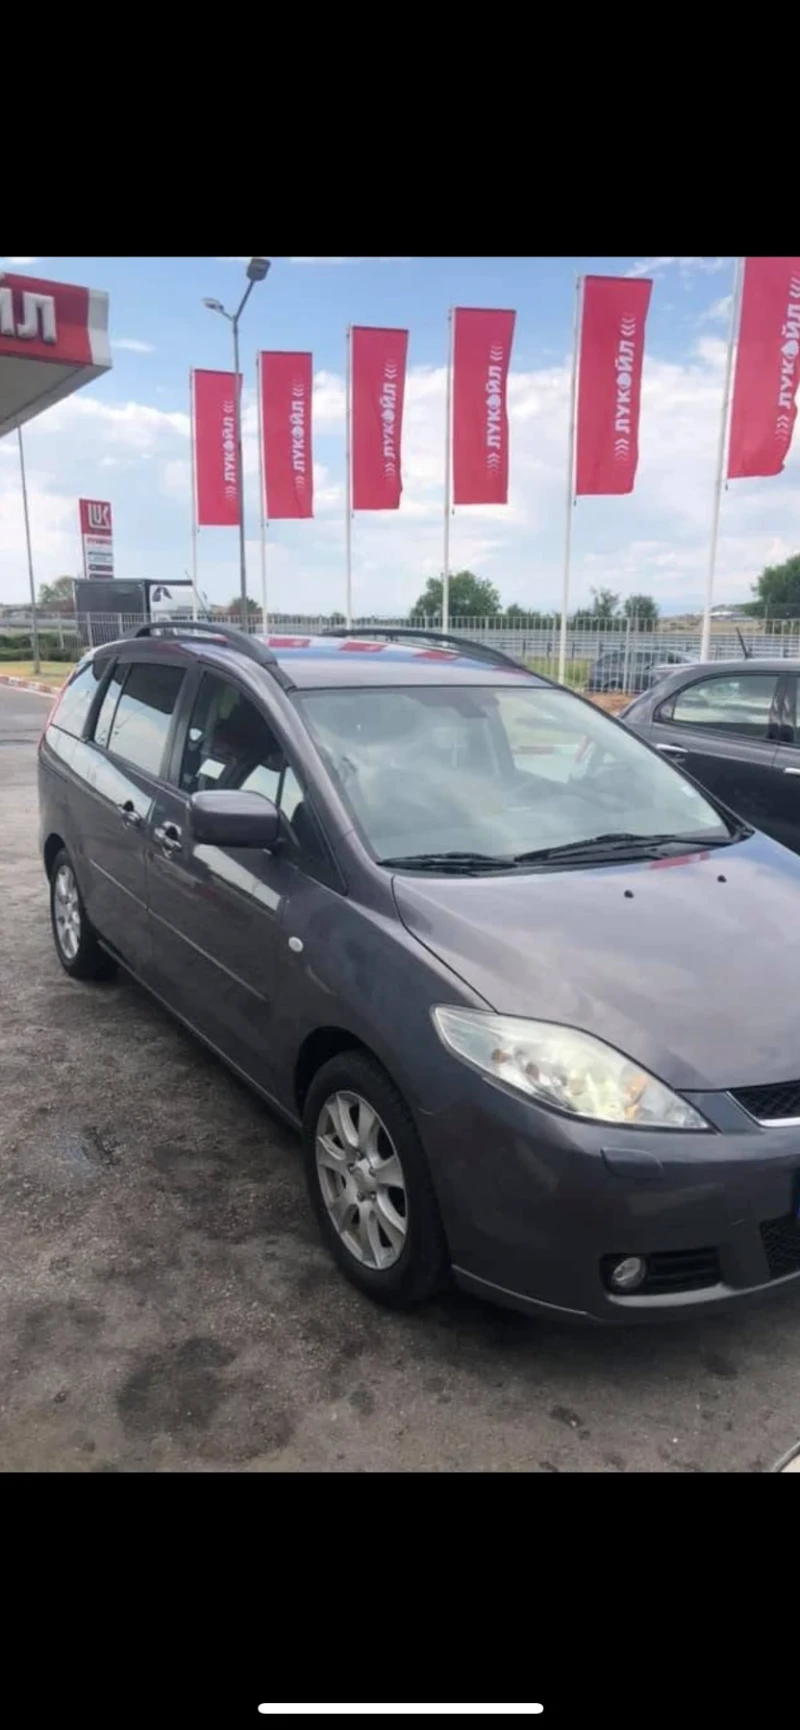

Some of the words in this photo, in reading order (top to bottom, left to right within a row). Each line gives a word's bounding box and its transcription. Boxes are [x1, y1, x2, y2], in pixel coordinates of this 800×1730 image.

[380, 382, 397, 458] ЛУКОЙЛ
[485, 365, 502, 449] ЛУКОЙЛ
[615, 339, 635, 434] ЛУКОЙЛ
[222, 416, 236, 483] ЛУКОЙЛ
[288, 400, 305, 473] ЛУКОЙЛ
